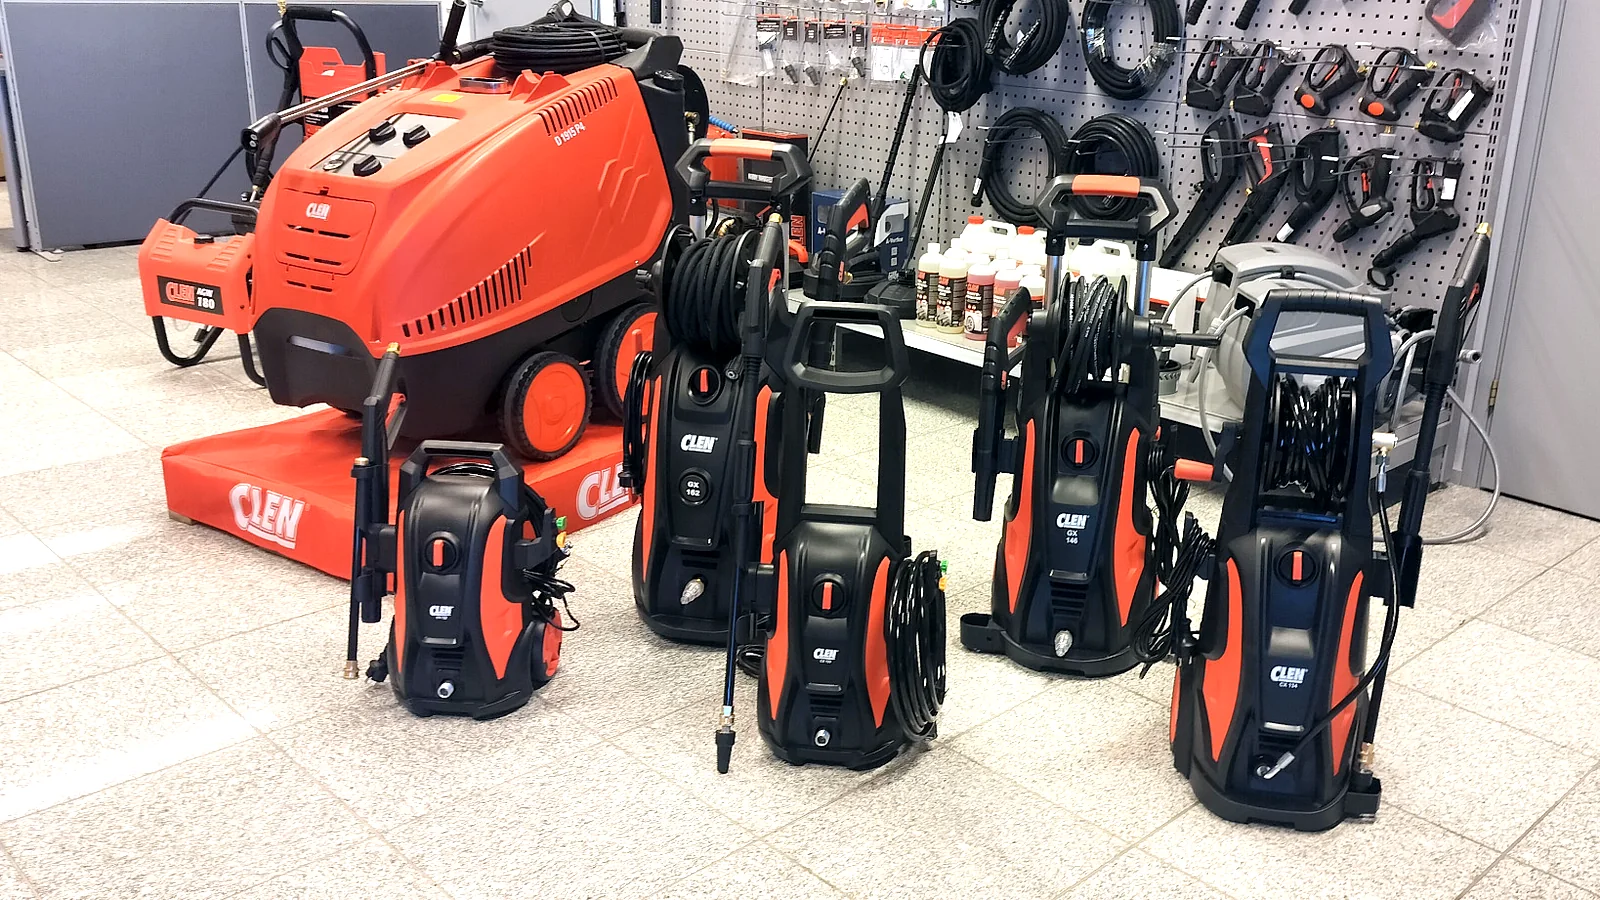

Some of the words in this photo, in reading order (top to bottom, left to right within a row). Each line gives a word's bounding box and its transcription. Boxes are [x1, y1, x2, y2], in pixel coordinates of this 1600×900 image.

[554, 135, 563, 147] D
[560, 126, 577, 143] 1915
[305, 202, 330, 220] CLEN
[790, 214, 806, 245] LEN
[165, 281, 195, 306] CLEN
[197, 296, 216, 310] 180
[680, 434, 716, 454] CLEN
[576, 461, 630, 520] CLE
[687, 480, 700, 489] GX
[228, 482, 305, 550] CLEN
[1056, 512, 1088, 530] CLEN
[1066, 529, 1078, 537] GX
[429, 605, 454, 617] CLEN
[813, 647, 839, 661] CLEN
[1270, 665, 1305, 684] CLEN
